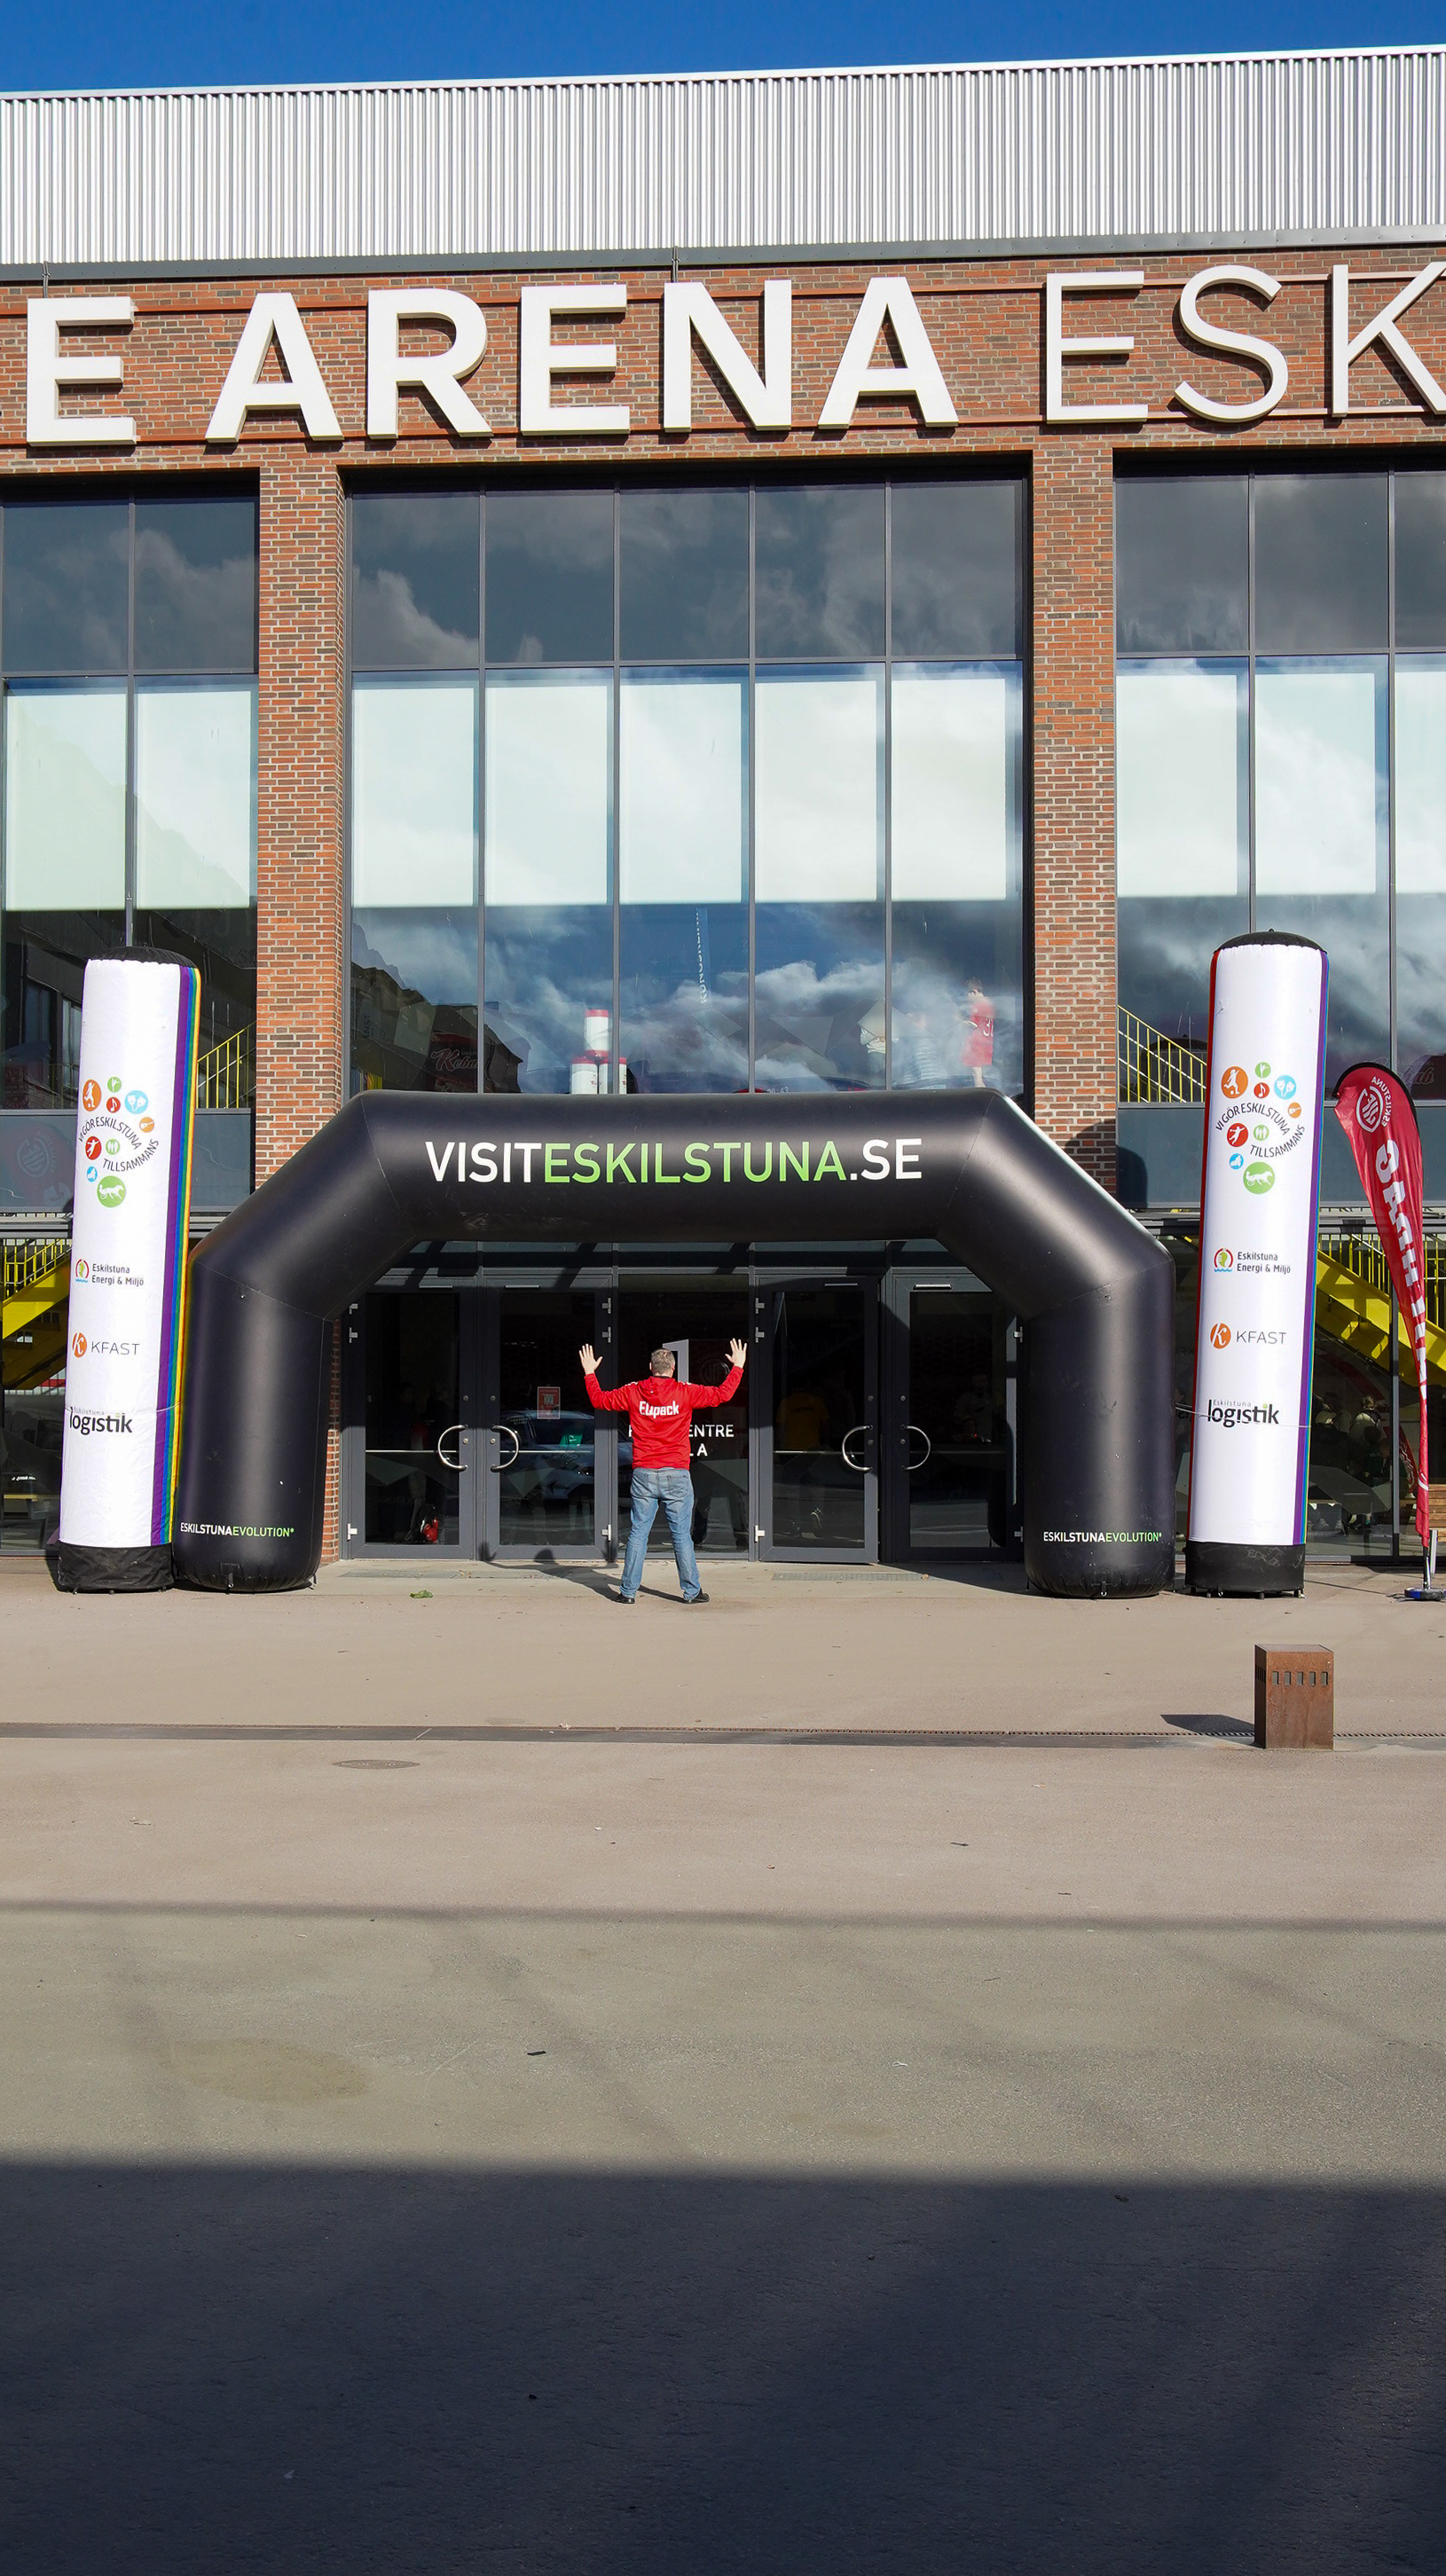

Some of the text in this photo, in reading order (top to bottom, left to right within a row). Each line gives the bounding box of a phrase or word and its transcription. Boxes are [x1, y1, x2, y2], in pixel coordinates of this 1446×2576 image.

[205, 277, 959, 443] ARENA
[1046, 261, 1446, 424] ESK
[95, 1116, 142, 1150] ESKILSTUNA
[1215, 1102, 1291, 1135] VI GÖR ESKILSTUNA
[102, 1139, 160, 1172] TILLSAMMANS
[1249, 1124, 1306, 1158] TILLSAMMANS
[424, 1138, 923, 1183] VISITESKILSTUNA.SE
[91, 1263, 130, 1274] Eskilstuna
[1237, 1251, 1278, 1261] Eskilstuna
[1237, 1262, 1291, 1275] Energi & Miljö
[91, 1275, 145, 1287] Energi & Miljö
[90, 1340, 140, 1355] KFAST
[1236, 1330, 1287, 1345] KFAST
[1207, 1399, 1280, 1428] logistik
[1213, 1399, 1252, 1408] Eskilstuna
[69, 1406, 133, 1435] logistik
